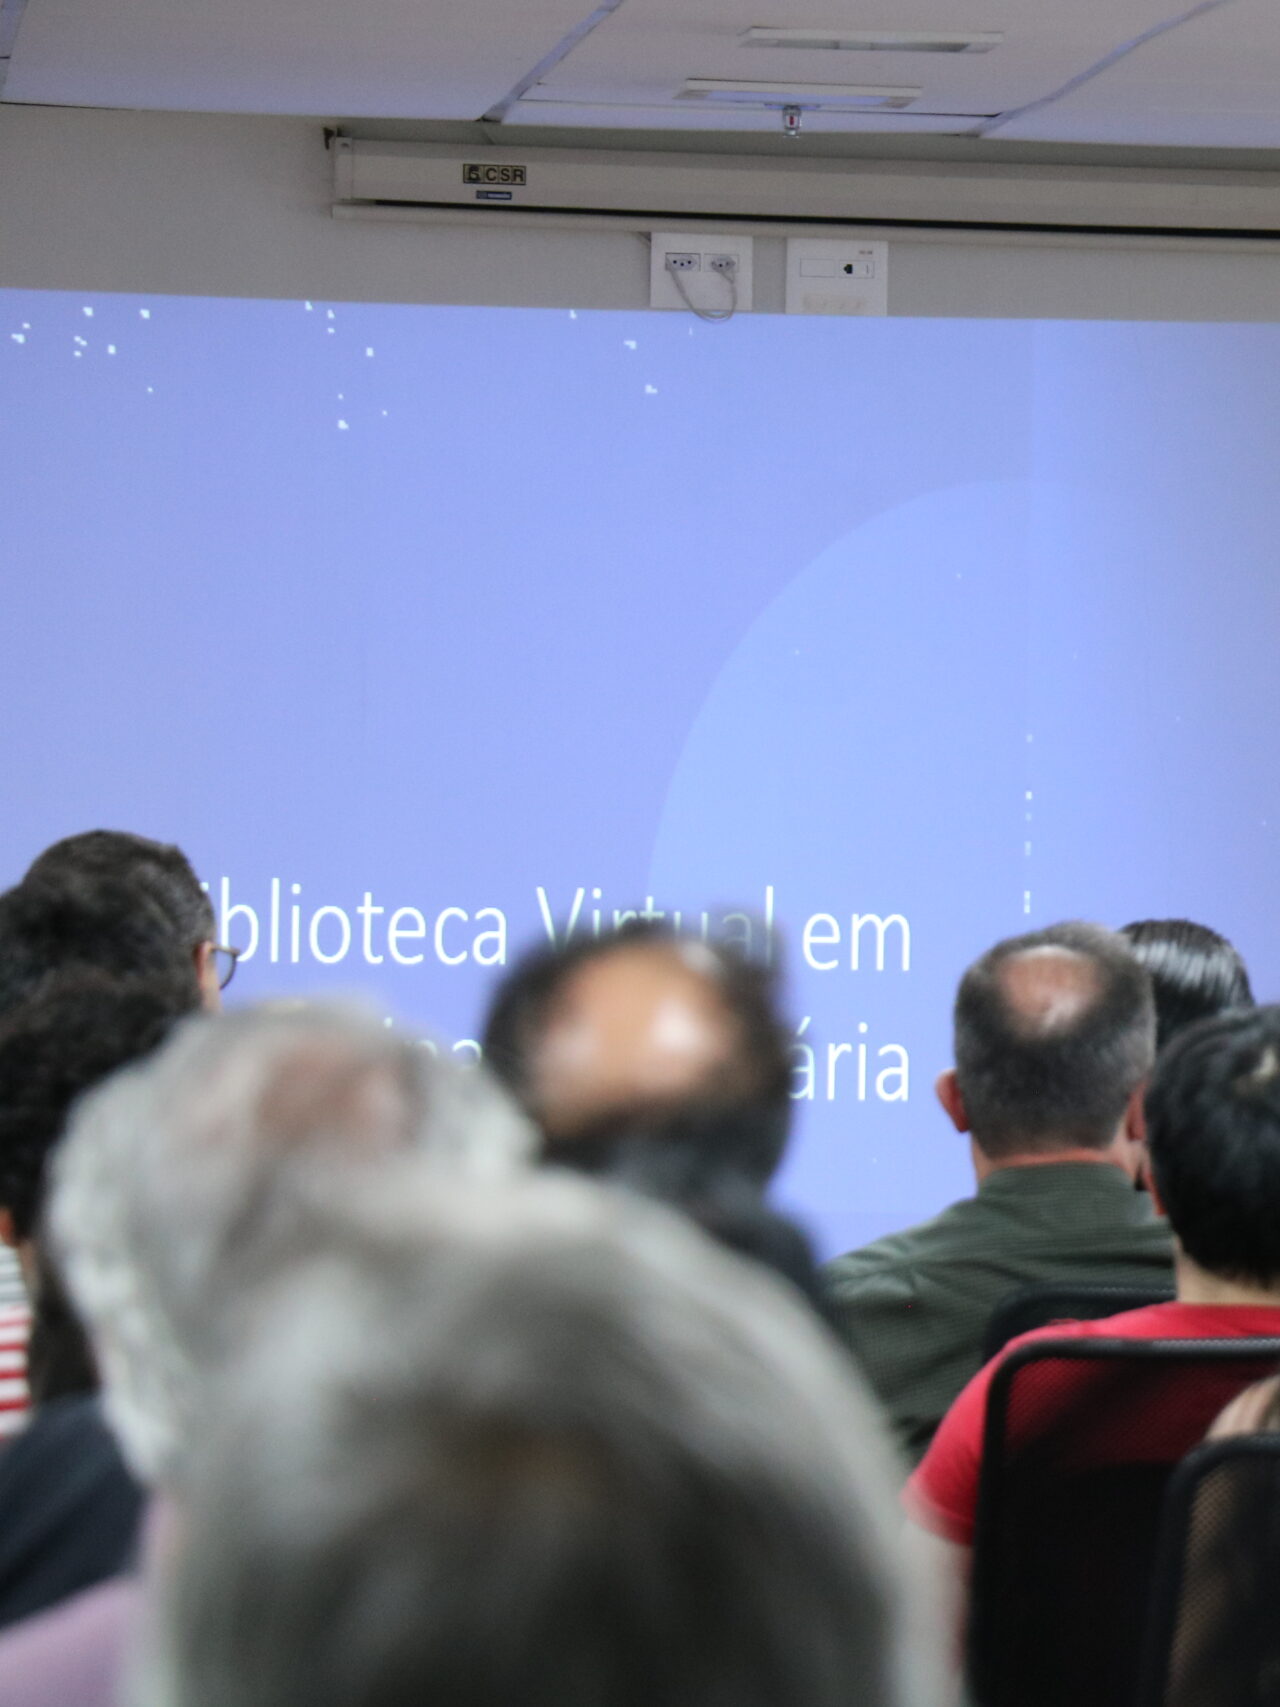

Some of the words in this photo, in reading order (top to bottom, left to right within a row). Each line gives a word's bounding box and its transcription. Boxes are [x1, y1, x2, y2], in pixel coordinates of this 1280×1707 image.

[485, 167, 524, 182] CSR
[200, 876, 507, 965] blioteca
[801, 904, 911, 971] em
[788, 1016, 909, 1101] ária
